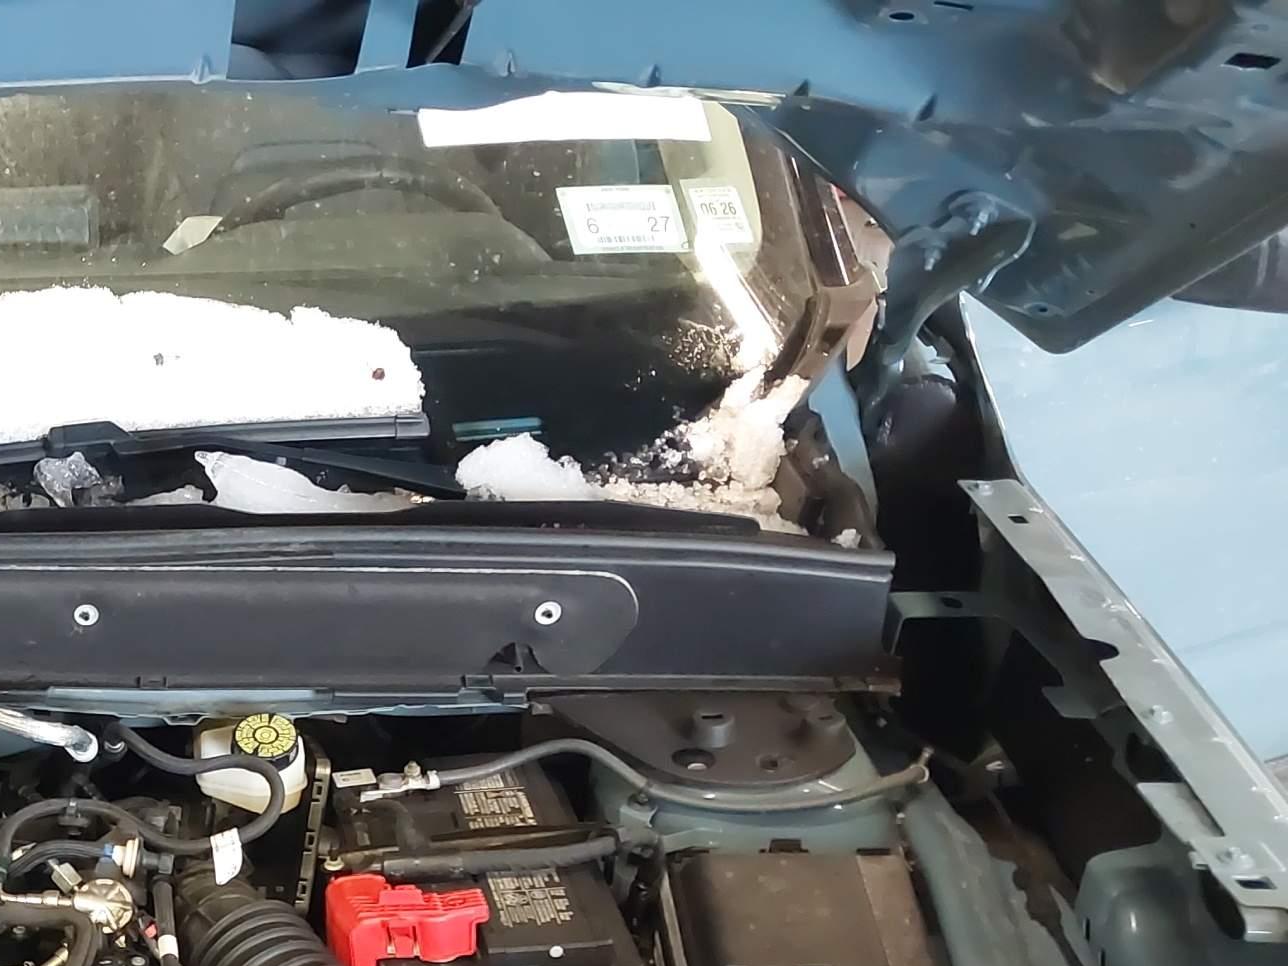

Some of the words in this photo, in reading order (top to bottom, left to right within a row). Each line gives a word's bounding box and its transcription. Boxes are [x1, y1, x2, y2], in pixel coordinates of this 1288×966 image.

[720, 201, 737, 216] 26
[586, 216, 600, 234] 6
[647, 215, 670, 233] 27
